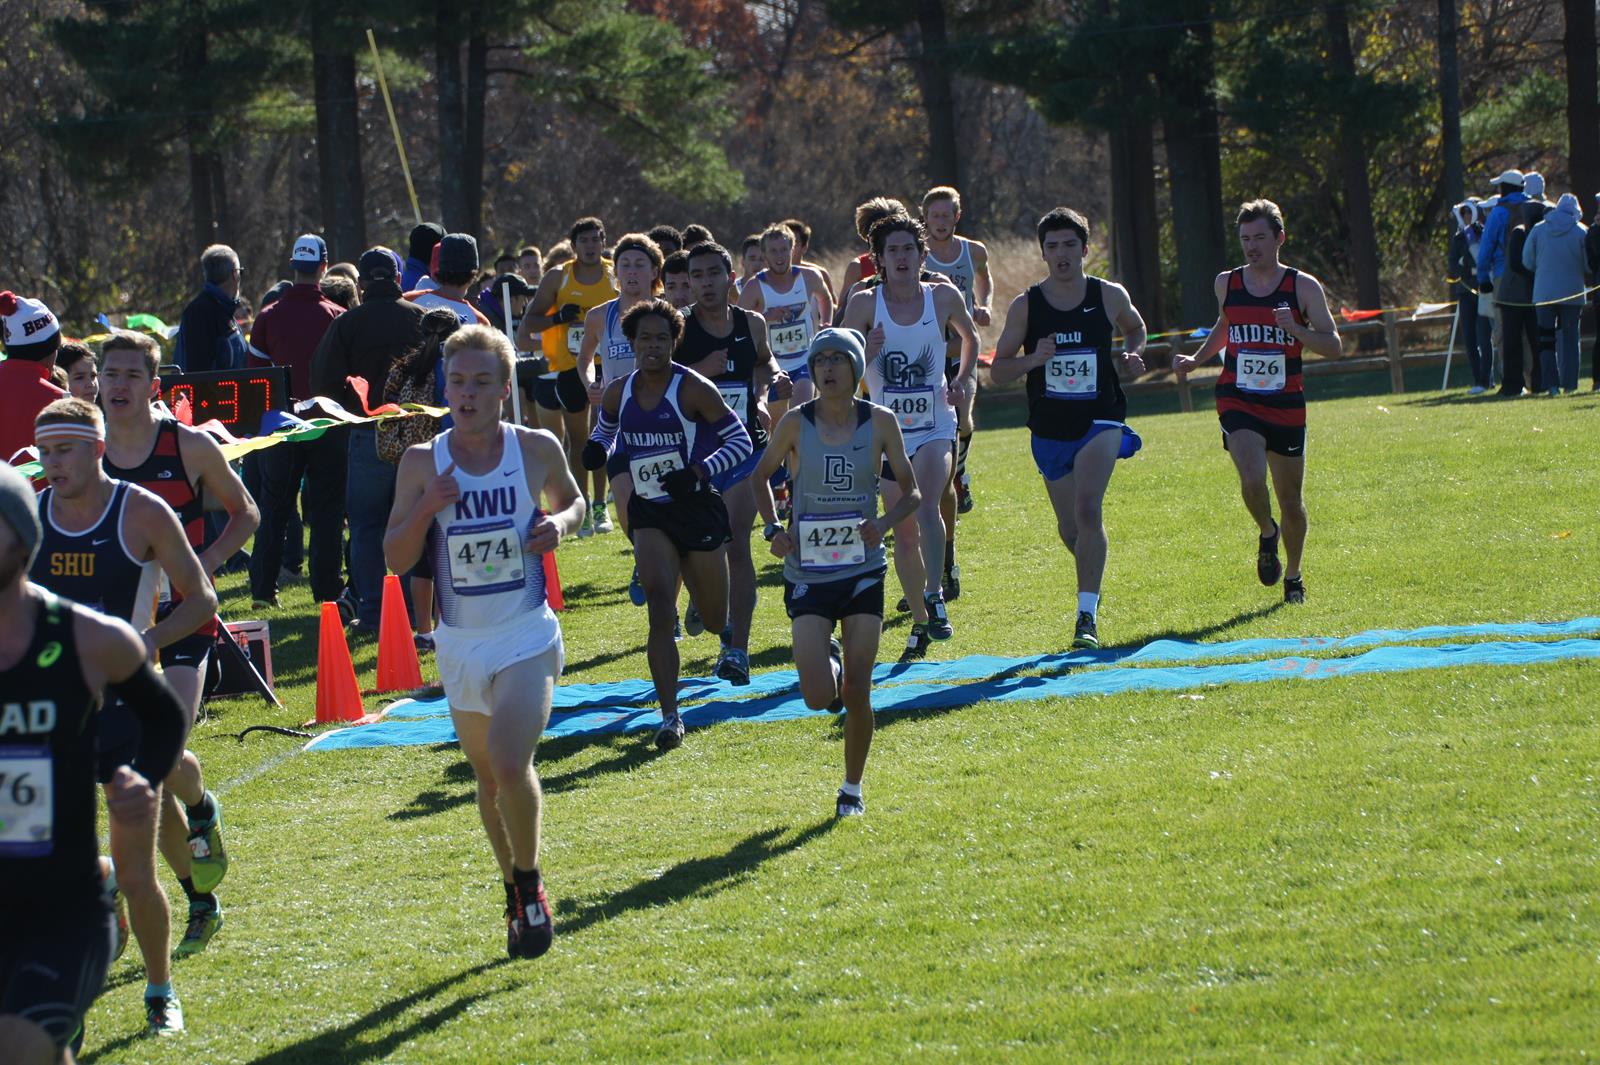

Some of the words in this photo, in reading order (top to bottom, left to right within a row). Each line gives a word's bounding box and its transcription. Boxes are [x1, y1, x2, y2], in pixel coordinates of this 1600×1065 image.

[775, 328, 803, 344] 445
[1056, 331, 1082, 345] OLLU
[1229, 323, 1295, 346] RAIDERS
[608, 343, 634, 359] BET
[1051, 359, 1090, 377] 554
[1243, 359, 1279, 376] 526
[889, 397, 928, 414] 408
[623, 431, 684, 447] WALDORF
[638, 459, 676, 482] 643
[823, 454, 856, 493] DS
[455, 485, 517, 521] KWU
[807, 525, 855, 547] 422
[457, 537, 513, 565] 474
[50, 552, 96, 577] SHU
